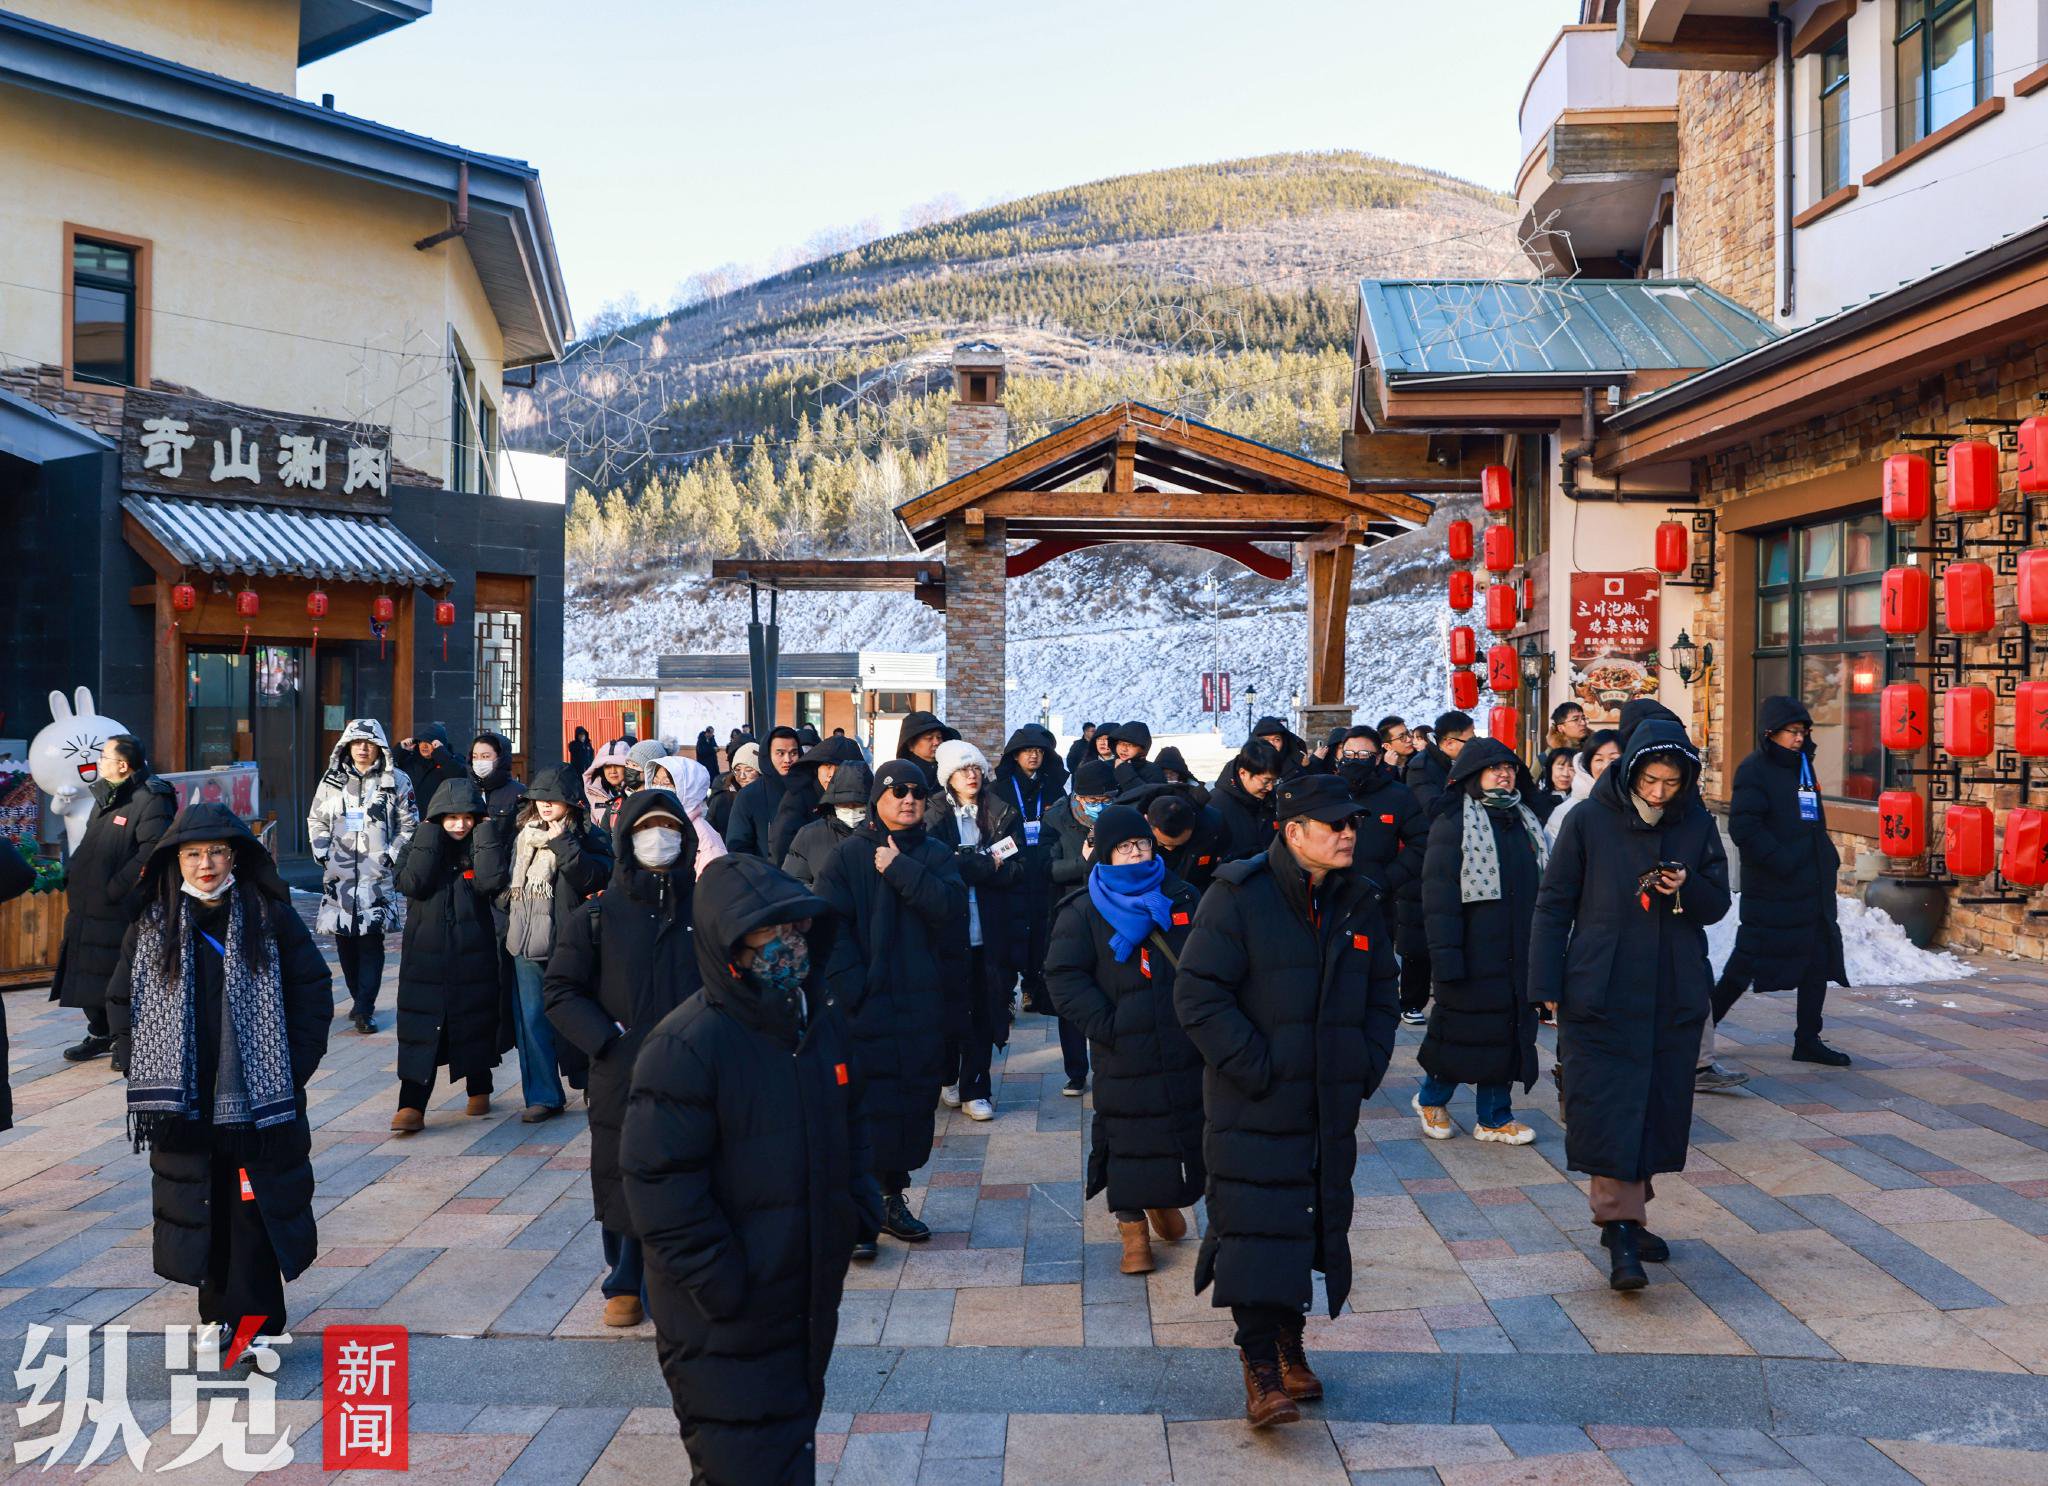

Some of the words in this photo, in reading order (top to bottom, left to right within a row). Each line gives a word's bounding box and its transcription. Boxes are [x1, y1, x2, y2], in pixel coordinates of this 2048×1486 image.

[140, 416, 388, 498] 奇山涮肉
[1576, 600, 1640, 617] 三川泡椒
[1588, 617, 1650, 635] 鸡杂米线
[1896, 705, 1923, 736] 火
[1881, 813, 1911, 840] 锅
